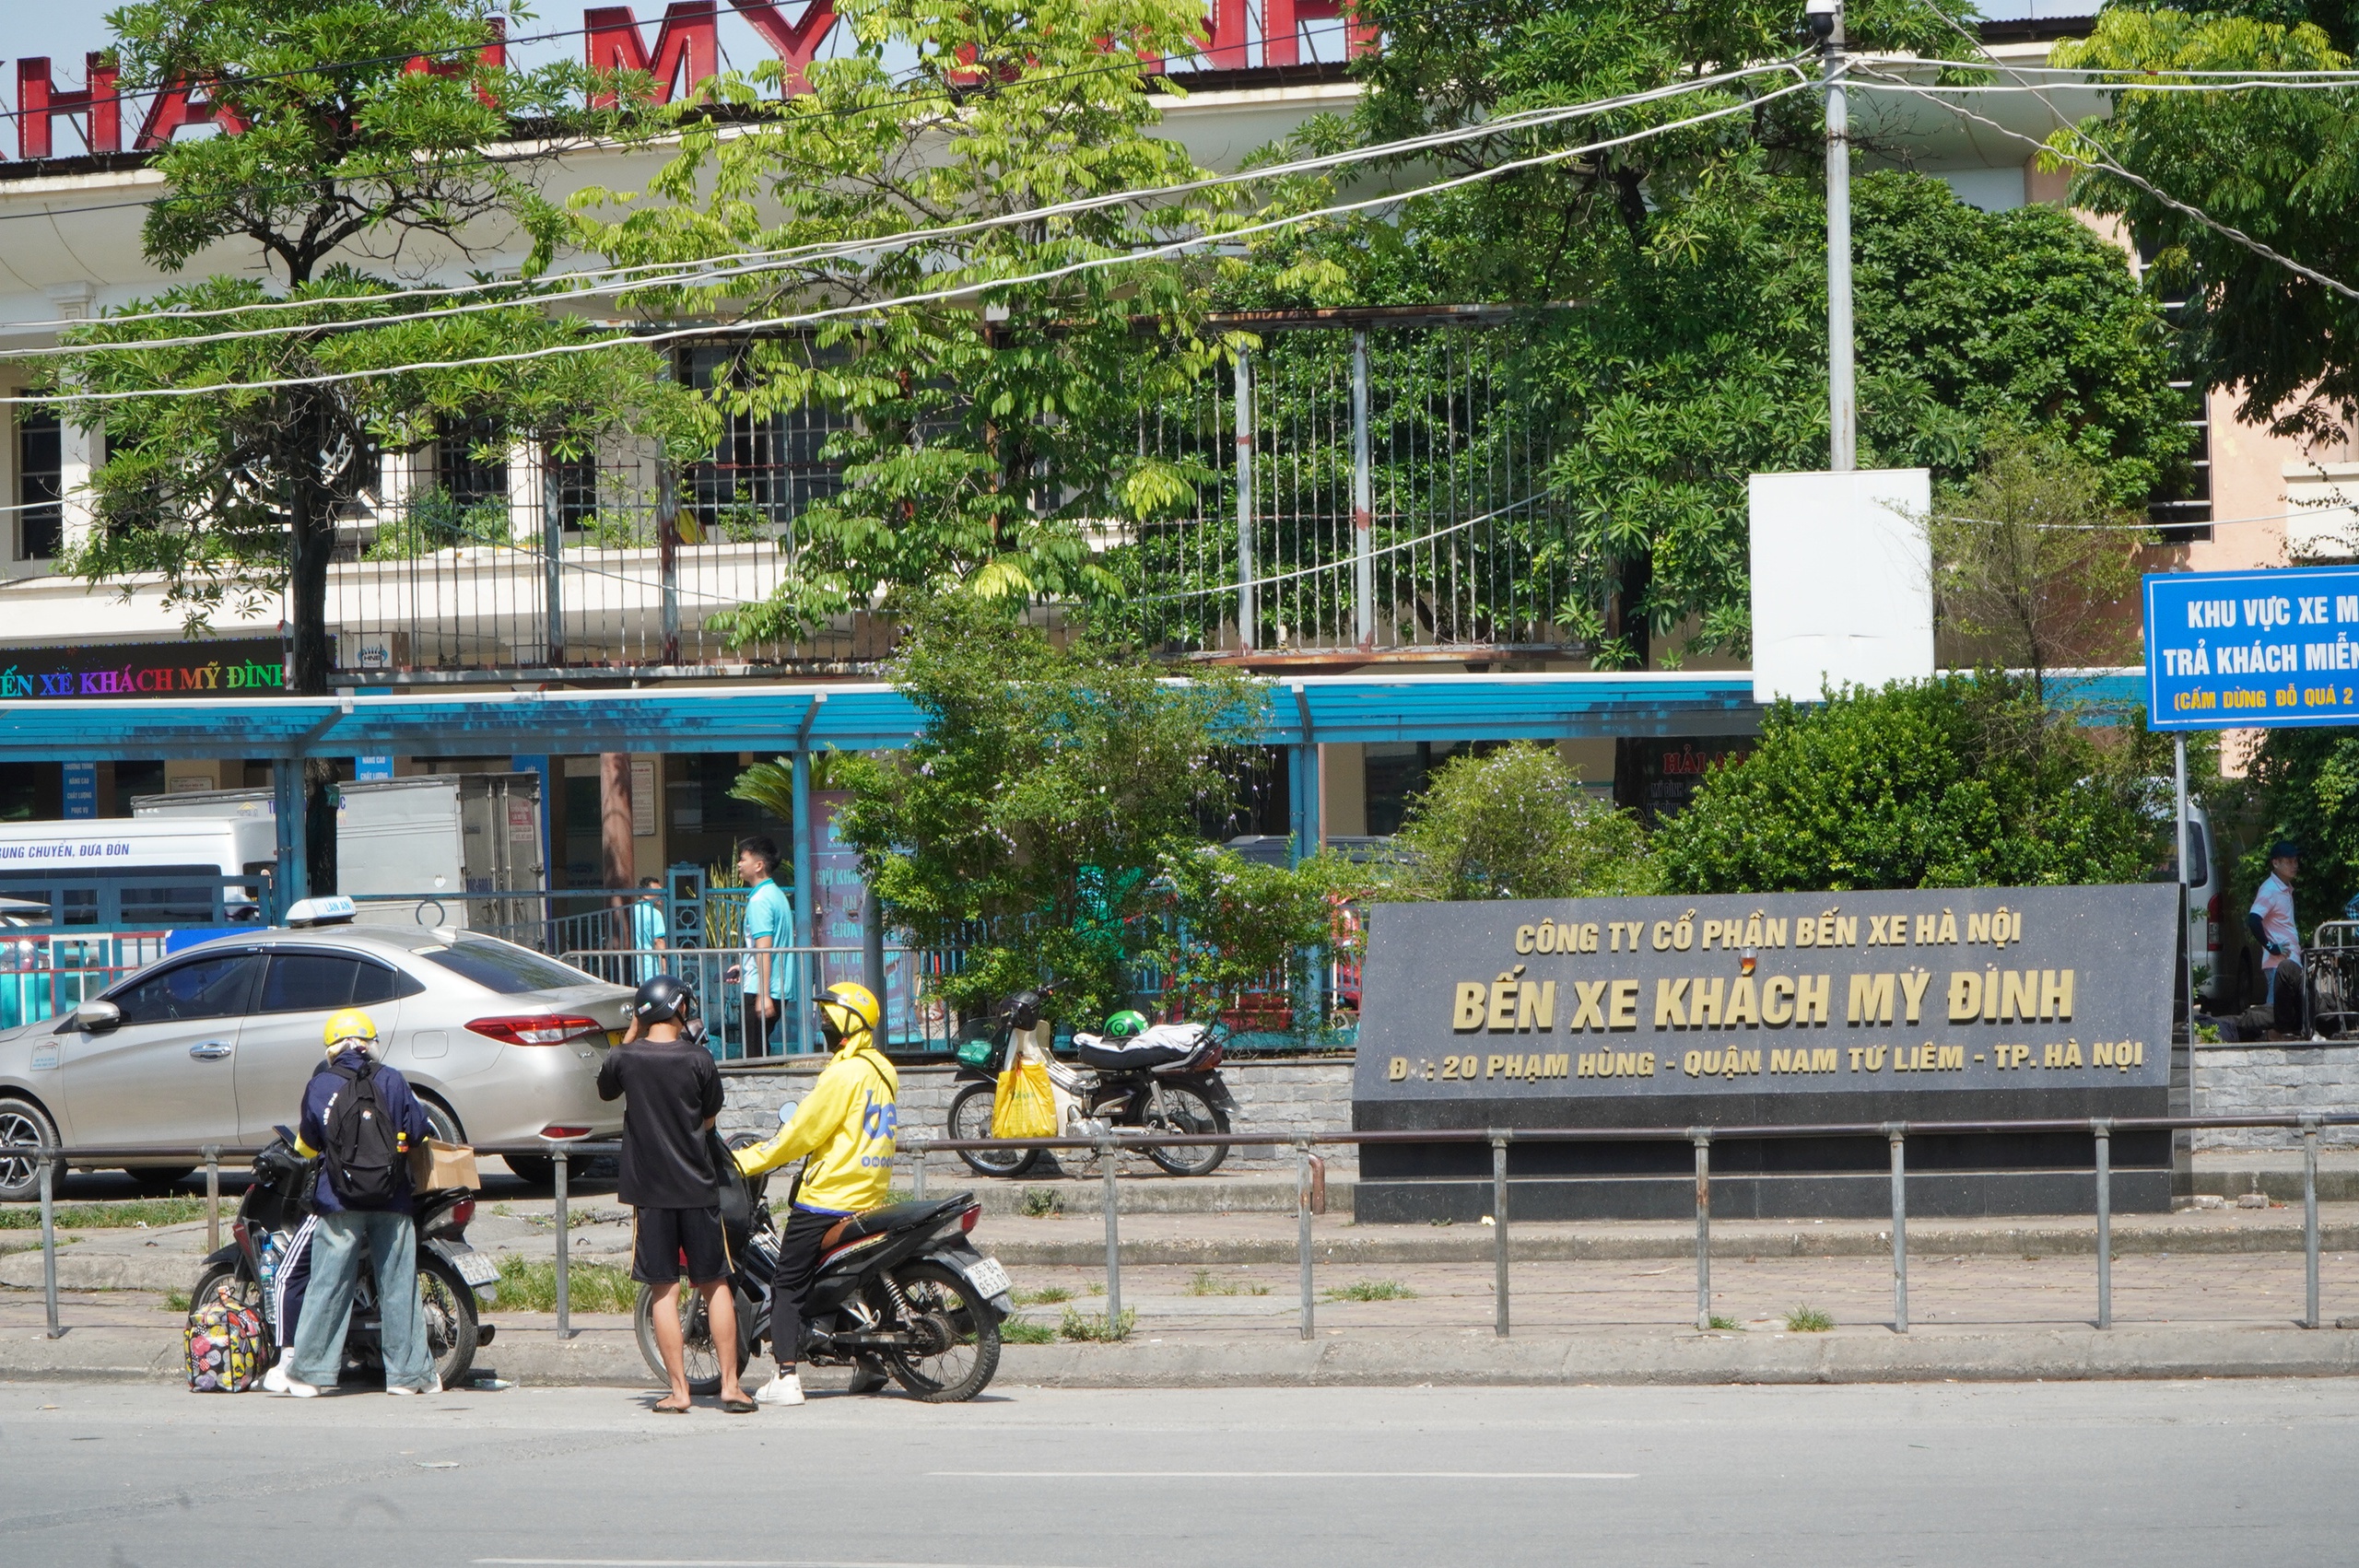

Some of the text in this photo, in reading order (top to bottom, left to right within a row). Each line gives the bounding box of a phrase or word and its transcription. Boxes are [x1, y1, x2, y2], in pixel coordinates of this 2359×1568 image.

[2188, 600, 2236, 628] KHU
[2243, 595, 2290, 631] VỰC
[2298, 596, 2329, 625] XE
[2163, 638, 2210, 676] TRẢ
[2216, 639, 2297, 674] KHÁCH
[79, 662, 173, 696] KHÁCH
[180, 661, 221, 691] MỸ
[2174, 683, 2353, 711] (CẤM DỪNG ĐỖ QUÁ 2
[1662, 743, 1706, 775] HẢI
[0, 846, 25, 860] UNG
[79, 843, 101, 857] ĐƯA
[106, 840, 130, 856] ĐÓN
[1515, 906, 2022, 954] CÔNG TY CỔ PHẦN BẾN XE HÀ NỘI
[1453, 965, 1556, 1035] BẾN
[1570, 979, 1639, 1034] XE
[1654, 965, 1831, 1032] KHÁCH
[1441, 1055, 1479, 1080] 20
[1486, 1053, 1569, 1083] PHẠM
[1578, 1046, 1656, 1078] HÙNG
[1684, 1045, 1761, 1080] QUẬN
[1770, 1047, 1837, 1075] NAM
[1894, 1040, 1964, 1072] LIÊM
[2044, 1037, 2083, 1070] HÀ
[863, 1089, 898, 1140] be
[979, 1272, 1012, 1295] 853.01
